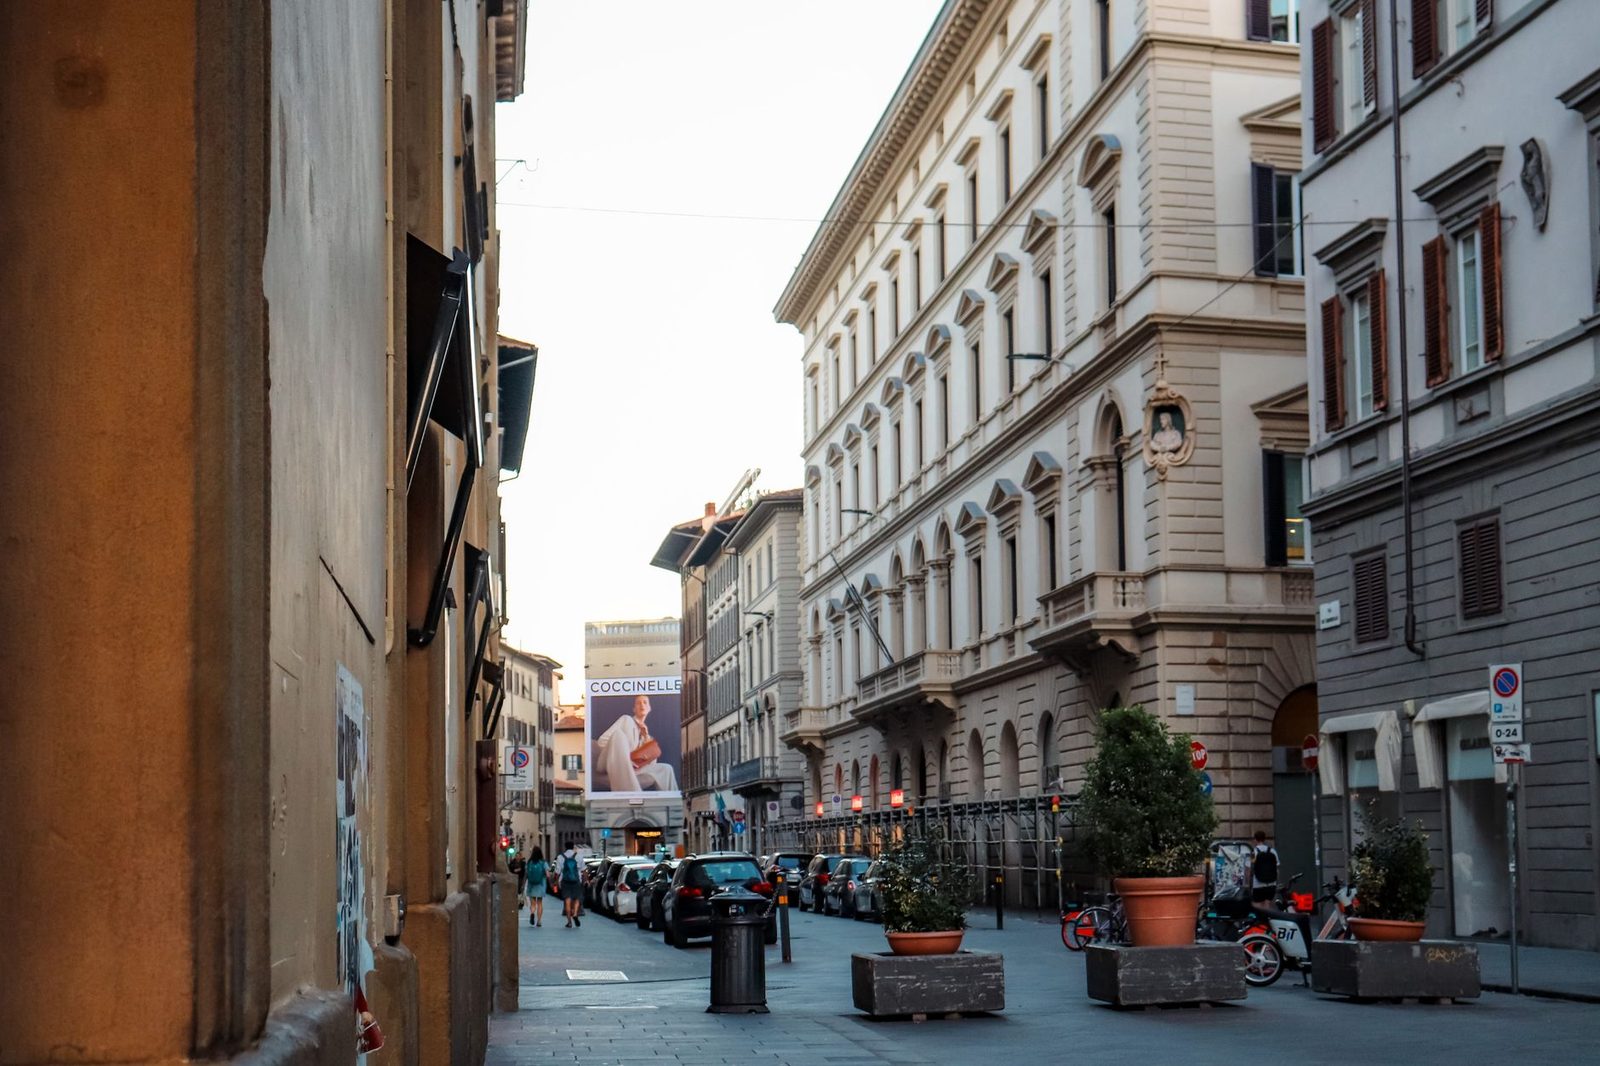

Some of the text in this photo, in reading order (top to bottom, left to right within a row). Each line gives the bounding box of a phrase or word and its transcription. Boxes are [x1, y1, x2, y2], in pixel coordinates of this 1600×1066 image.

[590, 679, 681, 693] COCCINELLE
[1495, 728, 1518, 738] 0-24
[1191, 748, 1206, 761] TOP
